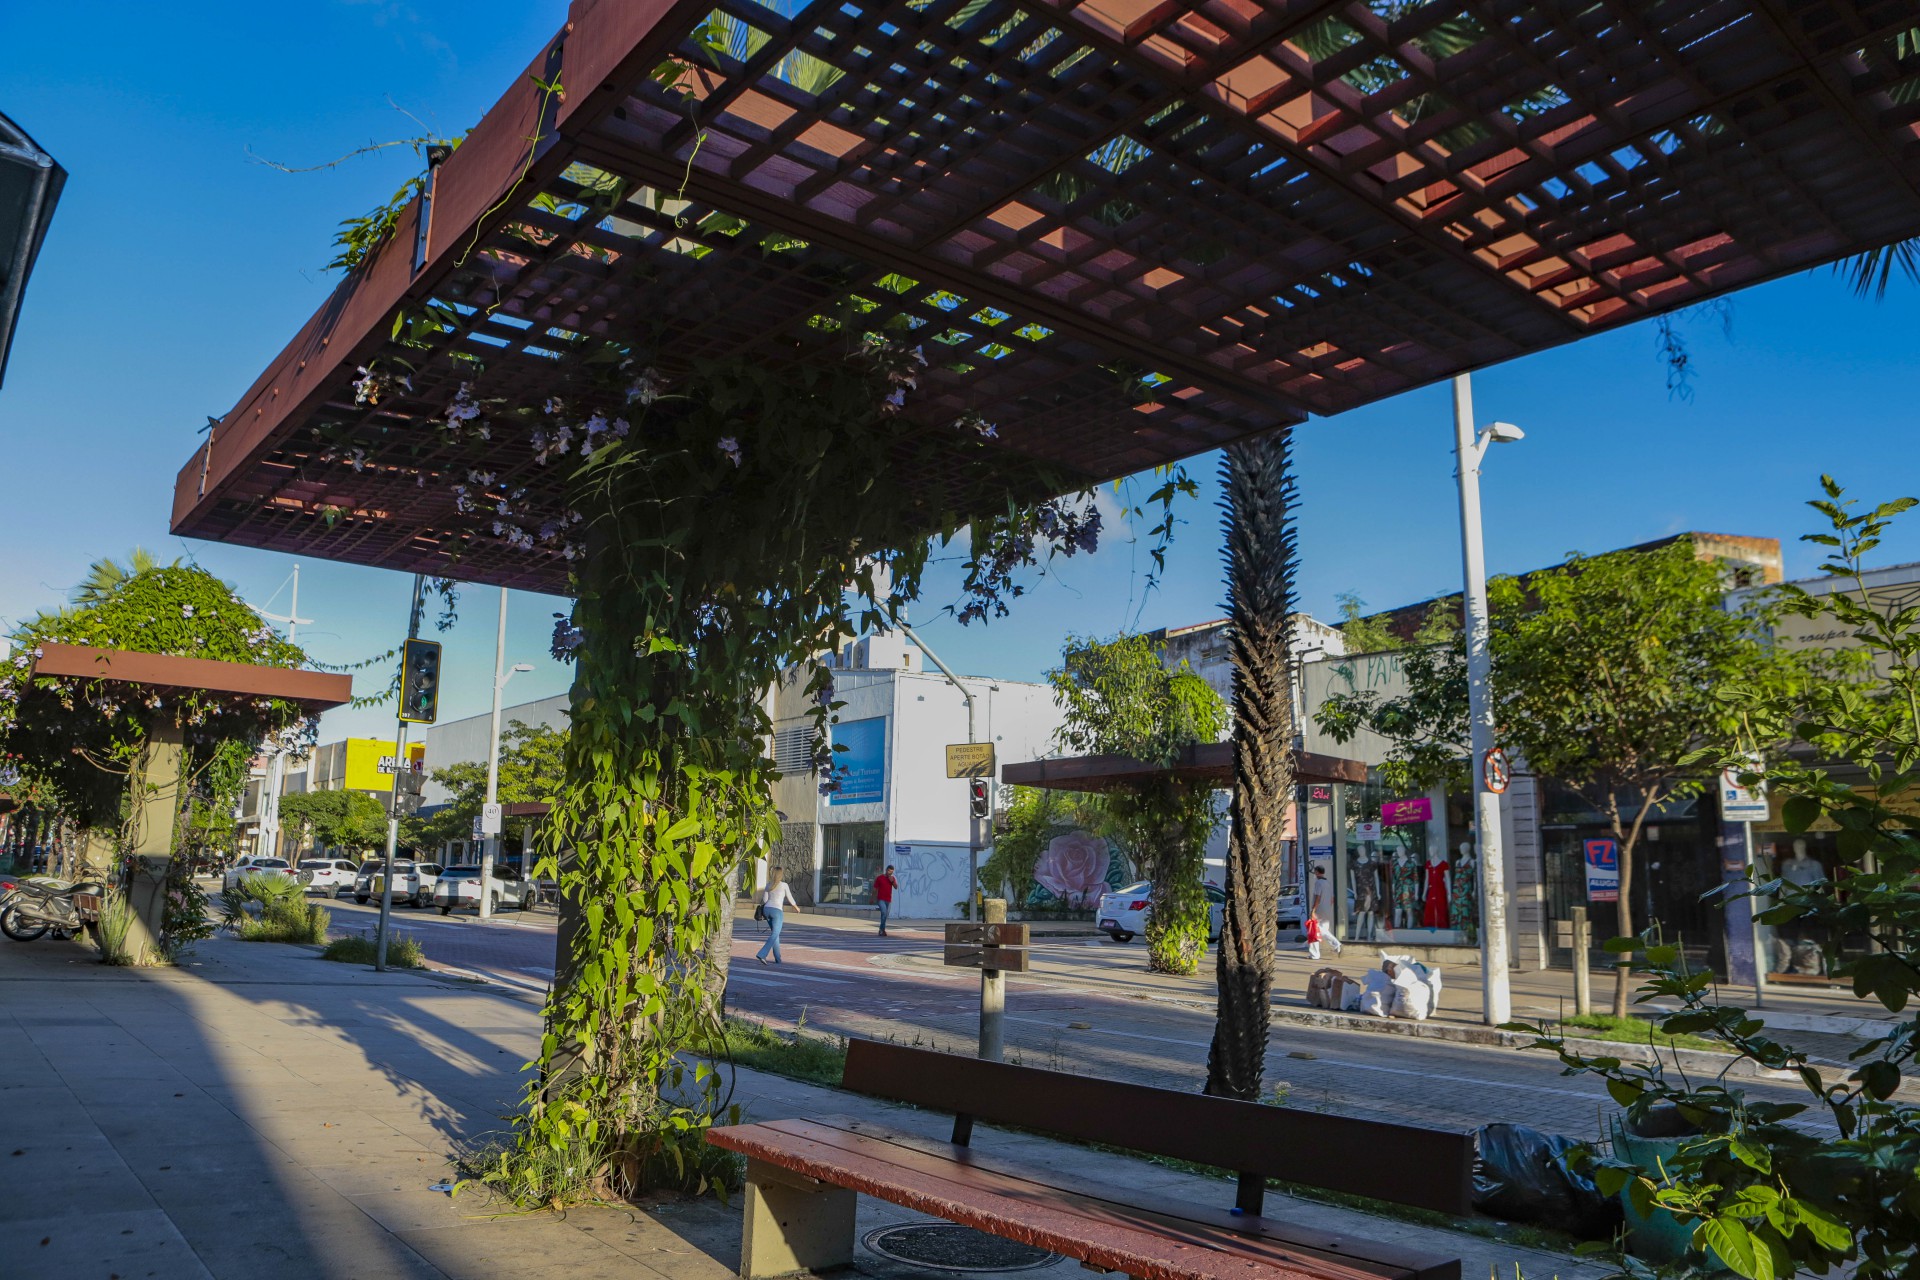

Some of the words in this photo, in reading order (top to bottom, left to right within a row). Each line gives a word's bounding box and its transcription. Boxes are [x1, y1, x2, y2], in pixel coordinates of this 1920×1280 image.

[1798, 630, 1848, 643] roupa
[1309, 826, 1323, 834] 344
[1586, 841, 1614, 863] FZ
